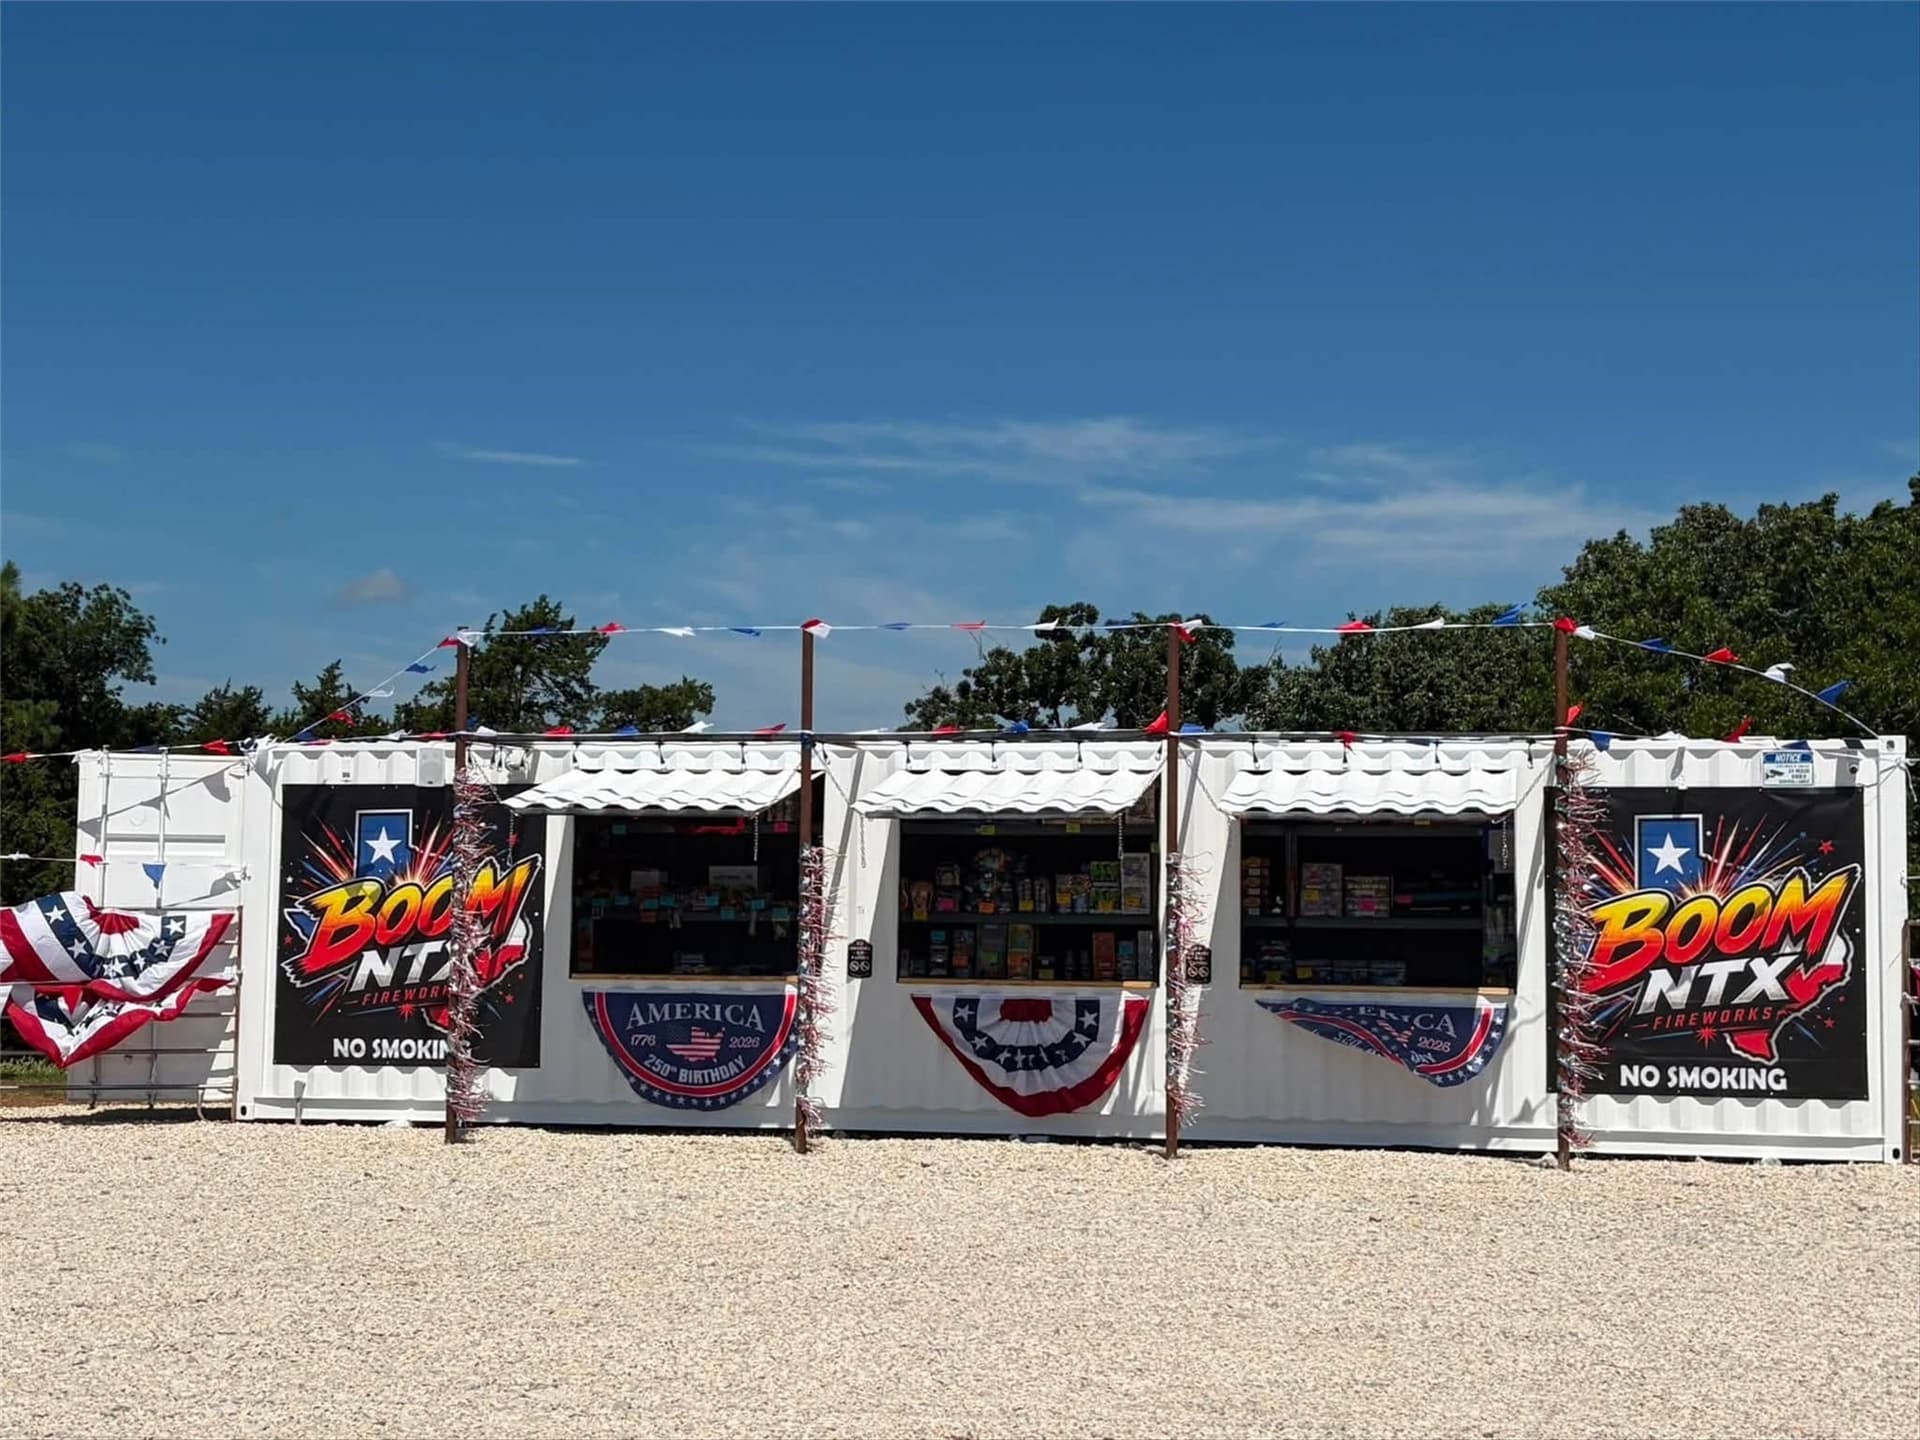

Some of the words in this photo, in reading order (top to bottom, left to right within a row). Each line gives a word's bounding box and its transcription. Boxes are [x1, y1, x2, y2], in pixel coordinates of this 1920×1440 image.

[1775, 753, 1802, 763] NOTICE
[299, 863, 532, 974] BOOM
[1581, 873, 1849, 994] BOOM
[361, 985, 450, 1006] FIREWOR
[1637, 954, 1800, 1015] NTX
[625, 1002, 766, 1033] AMERICA
[1652, 1007, 1773, 1031] FIREWORKS
[333, 1037, 367, 1059] NO
[371, 1038, 470, 1061] SMOKIN
[728, 1036, 760, 1049] 2026
[678, 1054, 747, 1085] BIRTHDAY
[1620, 1064, 1661, 1088] NO
[1667, 1066, 1787, 1091] SMOKING
